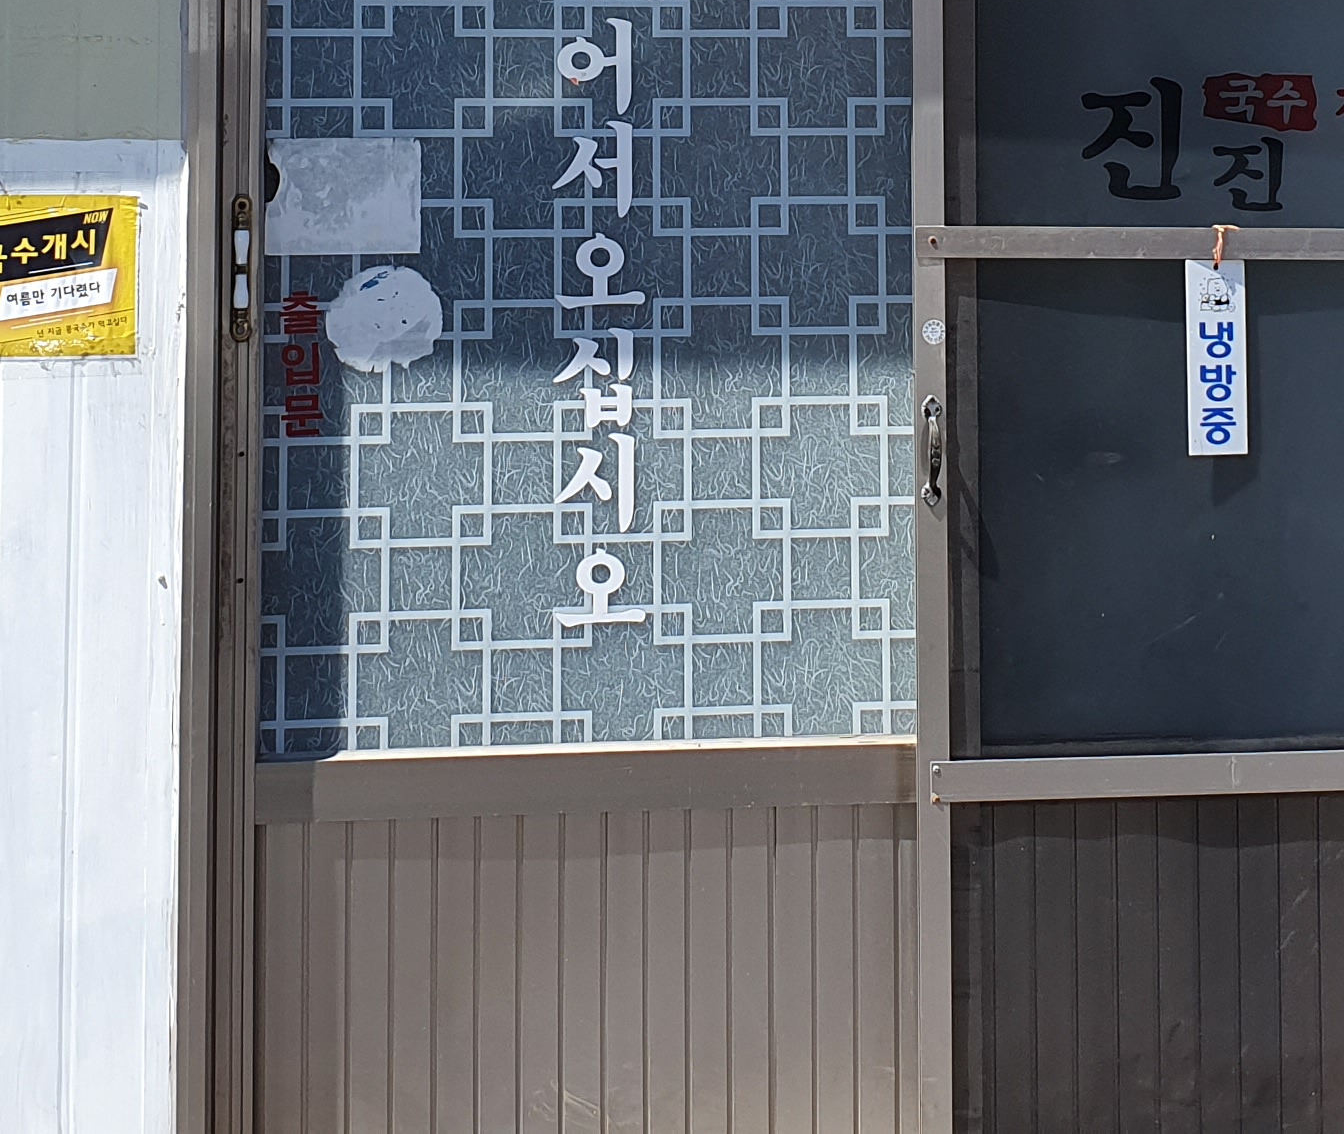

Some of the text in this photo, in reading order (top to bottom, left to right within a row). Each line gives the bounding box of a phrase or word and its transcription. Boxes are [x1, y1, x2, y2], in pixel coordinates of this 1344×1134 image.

[1080, 76, 1285, 211] 진 진
[1218, 79, 1310, 124] 국수
[83, 210, 110, 226] NOW
[6, 281, 101, 306] 여름만 기다렸다
[552, 16, 647, 627] 어서오십시오
[279, 290, 324, 437] 출입문
[1198, 321, 1237, 445] 냉방중
